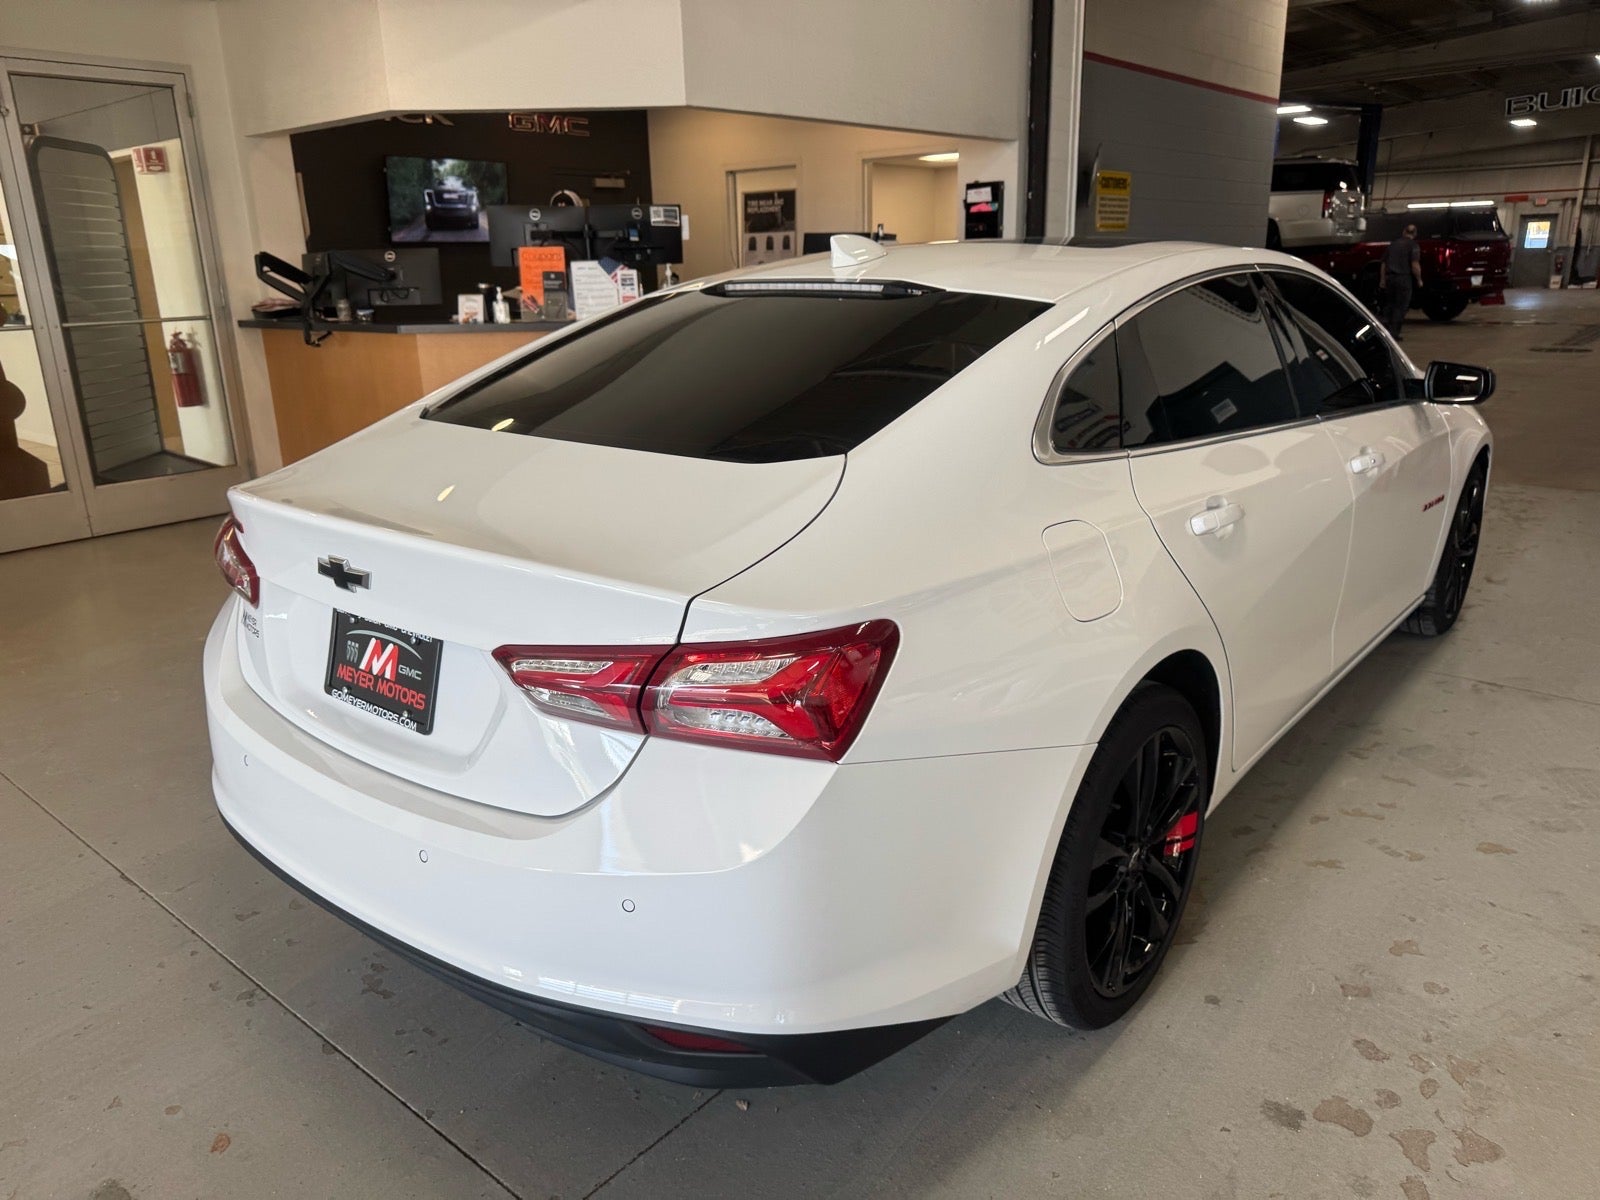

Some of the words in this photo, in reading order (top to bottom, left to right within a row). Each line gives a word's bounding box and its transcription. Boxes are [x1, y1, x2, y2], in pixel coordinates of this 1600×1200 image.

[508, 112, 590, 136] GMC
[336, 663, 375, 692] MEYER
[376, 678, 427, 710] MOTORS
[398, 664, 423, 681] GMC
[331, 688, 418, 732] GOMEYERMOTORS.COM
